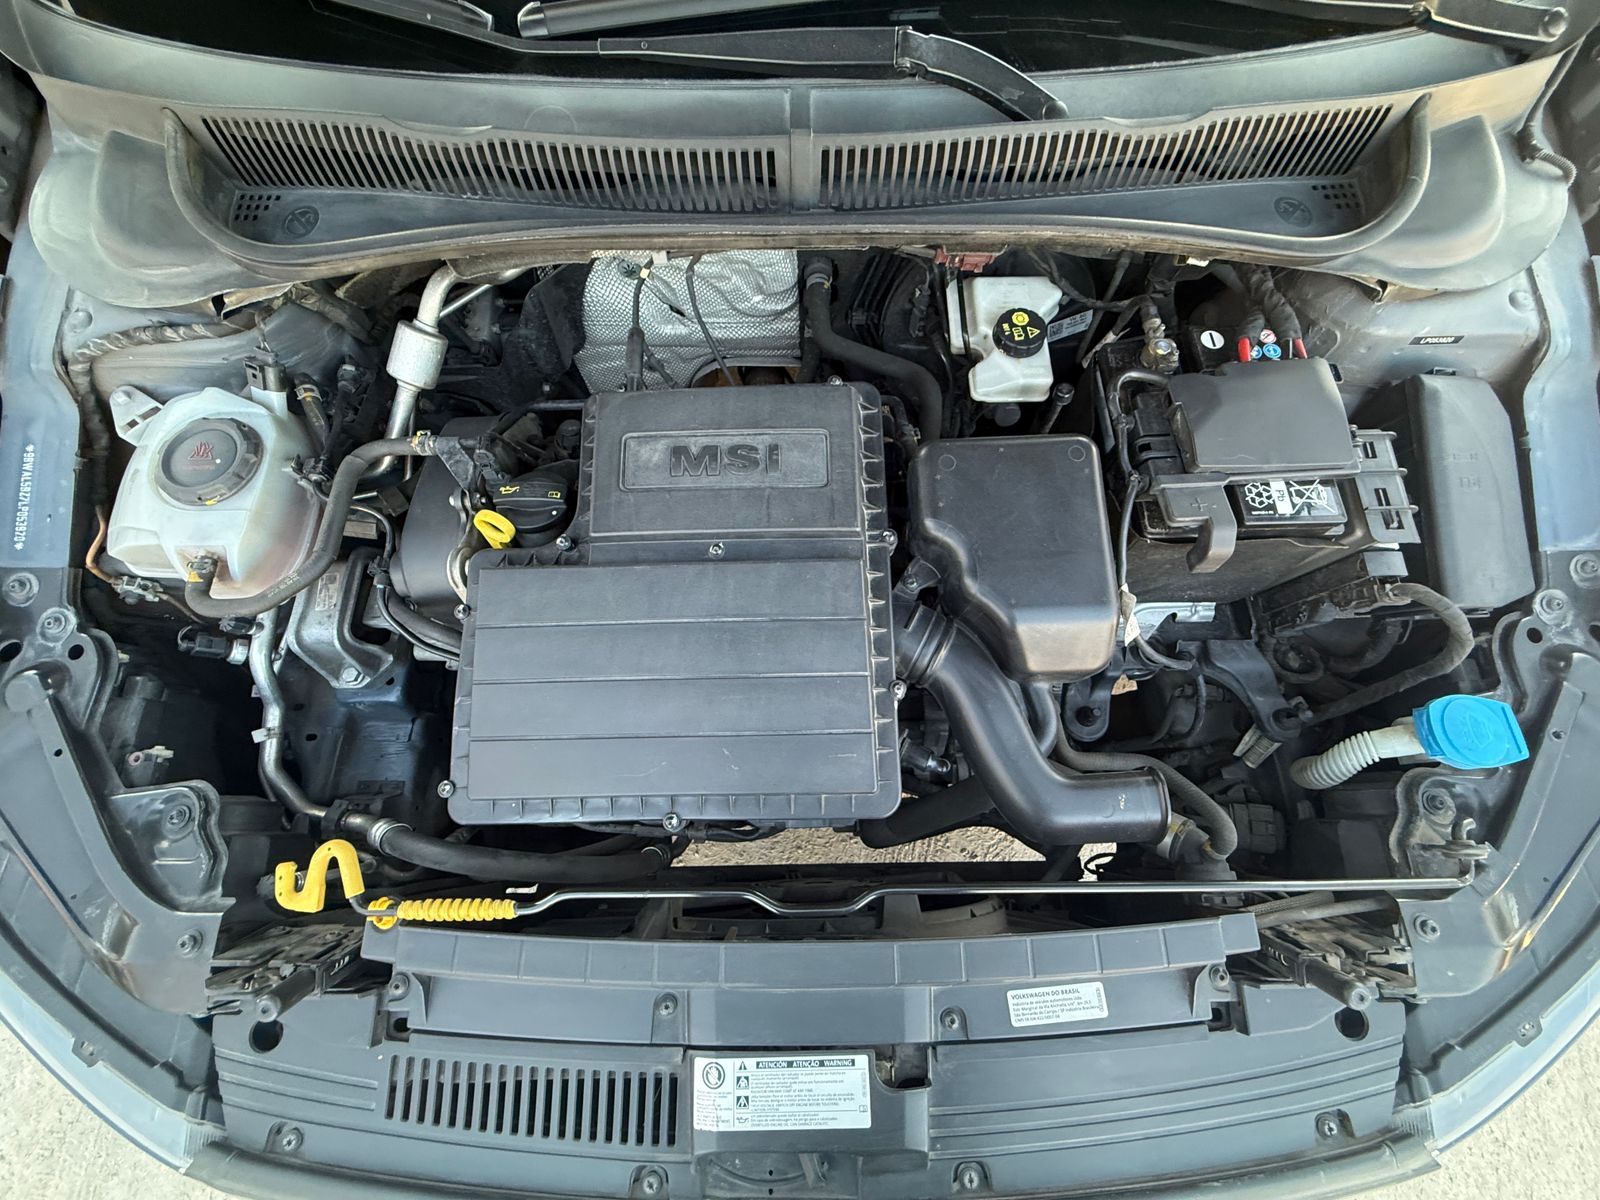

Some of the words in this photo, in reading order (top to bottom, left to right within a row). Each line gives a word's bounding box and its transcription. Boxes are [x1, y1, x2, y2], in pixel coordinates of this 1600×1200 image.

[670, 443, 782, 477] MSI
[1275, 489, 1286, 501] Pb
[1011, 990, 1050, 1000] VOLKSWAGEN
[758, 1060, 787, 1068] ATENCIÓN
[792, 1060, 820, 1069] ATENÇÃO
[823, 1059, 852, 1067] WARNING
